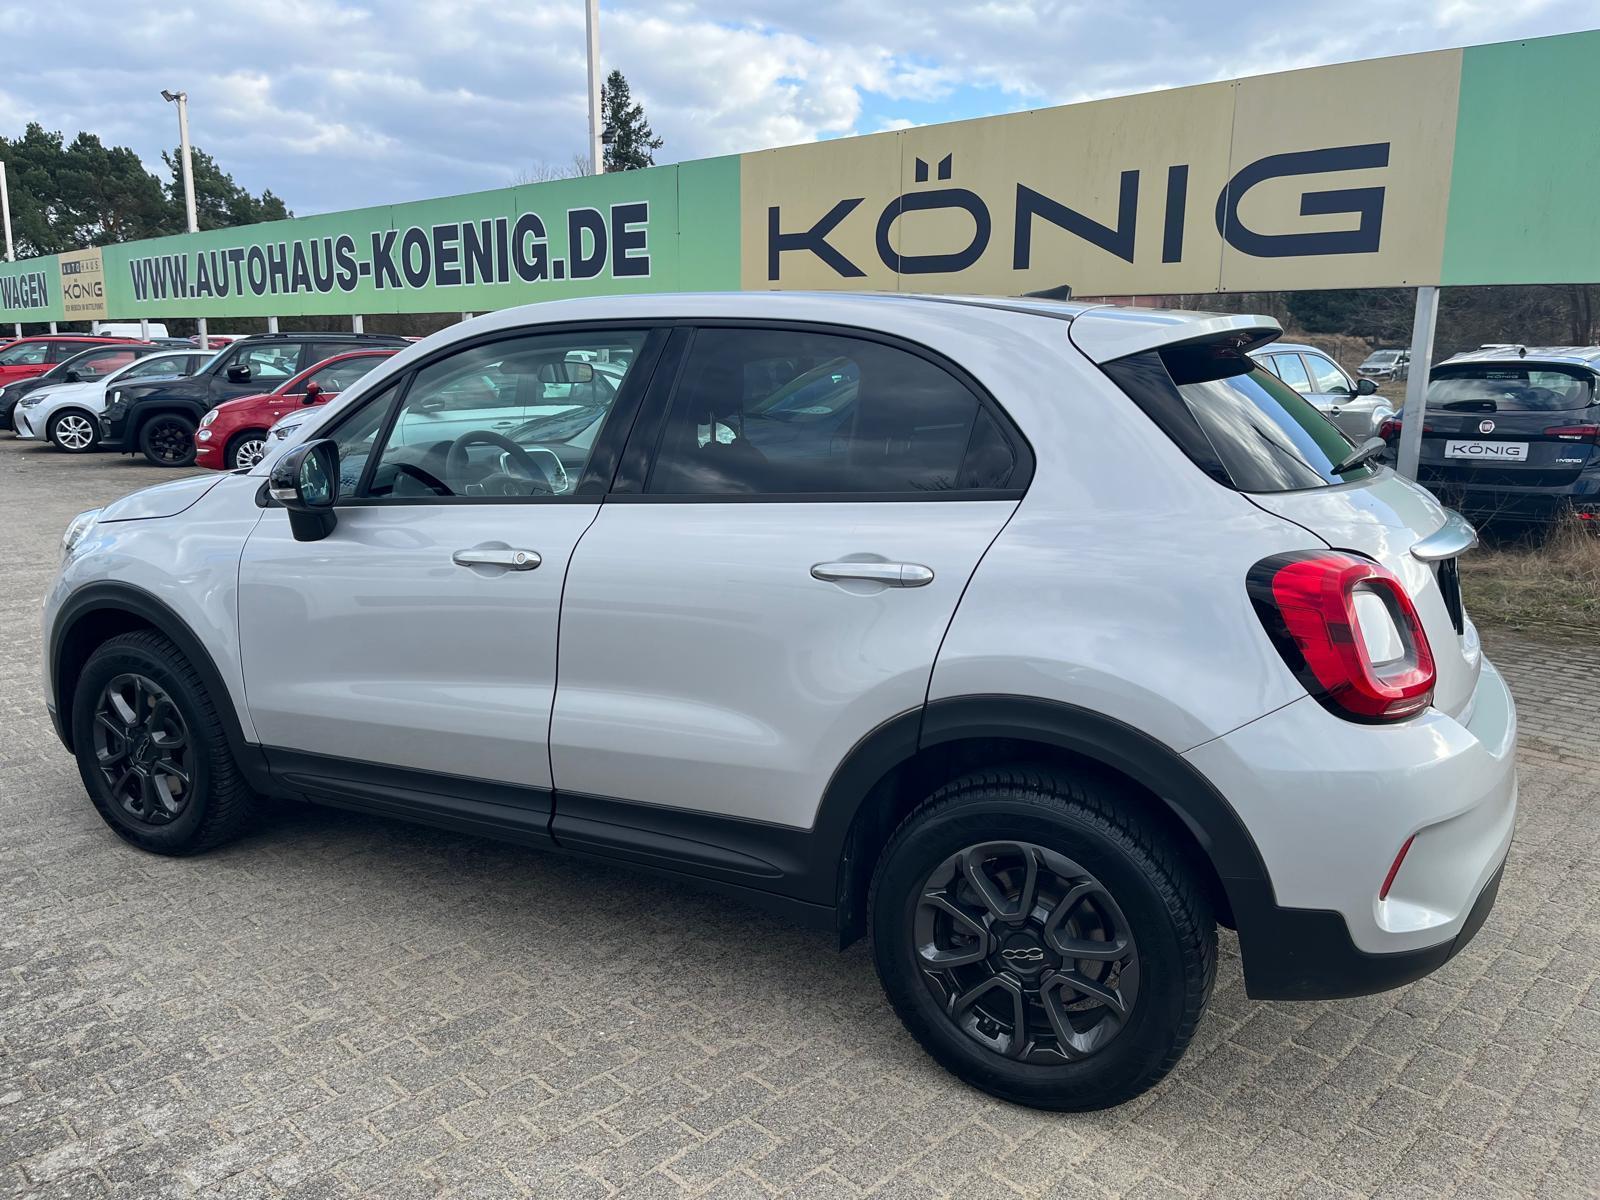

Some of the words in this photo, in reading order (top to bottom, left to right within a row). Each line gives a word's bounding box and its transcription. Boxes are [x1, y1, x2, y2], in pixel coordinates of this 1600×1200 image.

[768, 142, 1390, 280] KÖNIG
[129, 201, 650, 301] WWW.AUTOHAUS-KOENIG.DE
[0, 272, 48, 309] WAGEN
[64, 278, 103, 300] KÖNIG
[1452, 442, 1521, 456] KÖNIG
